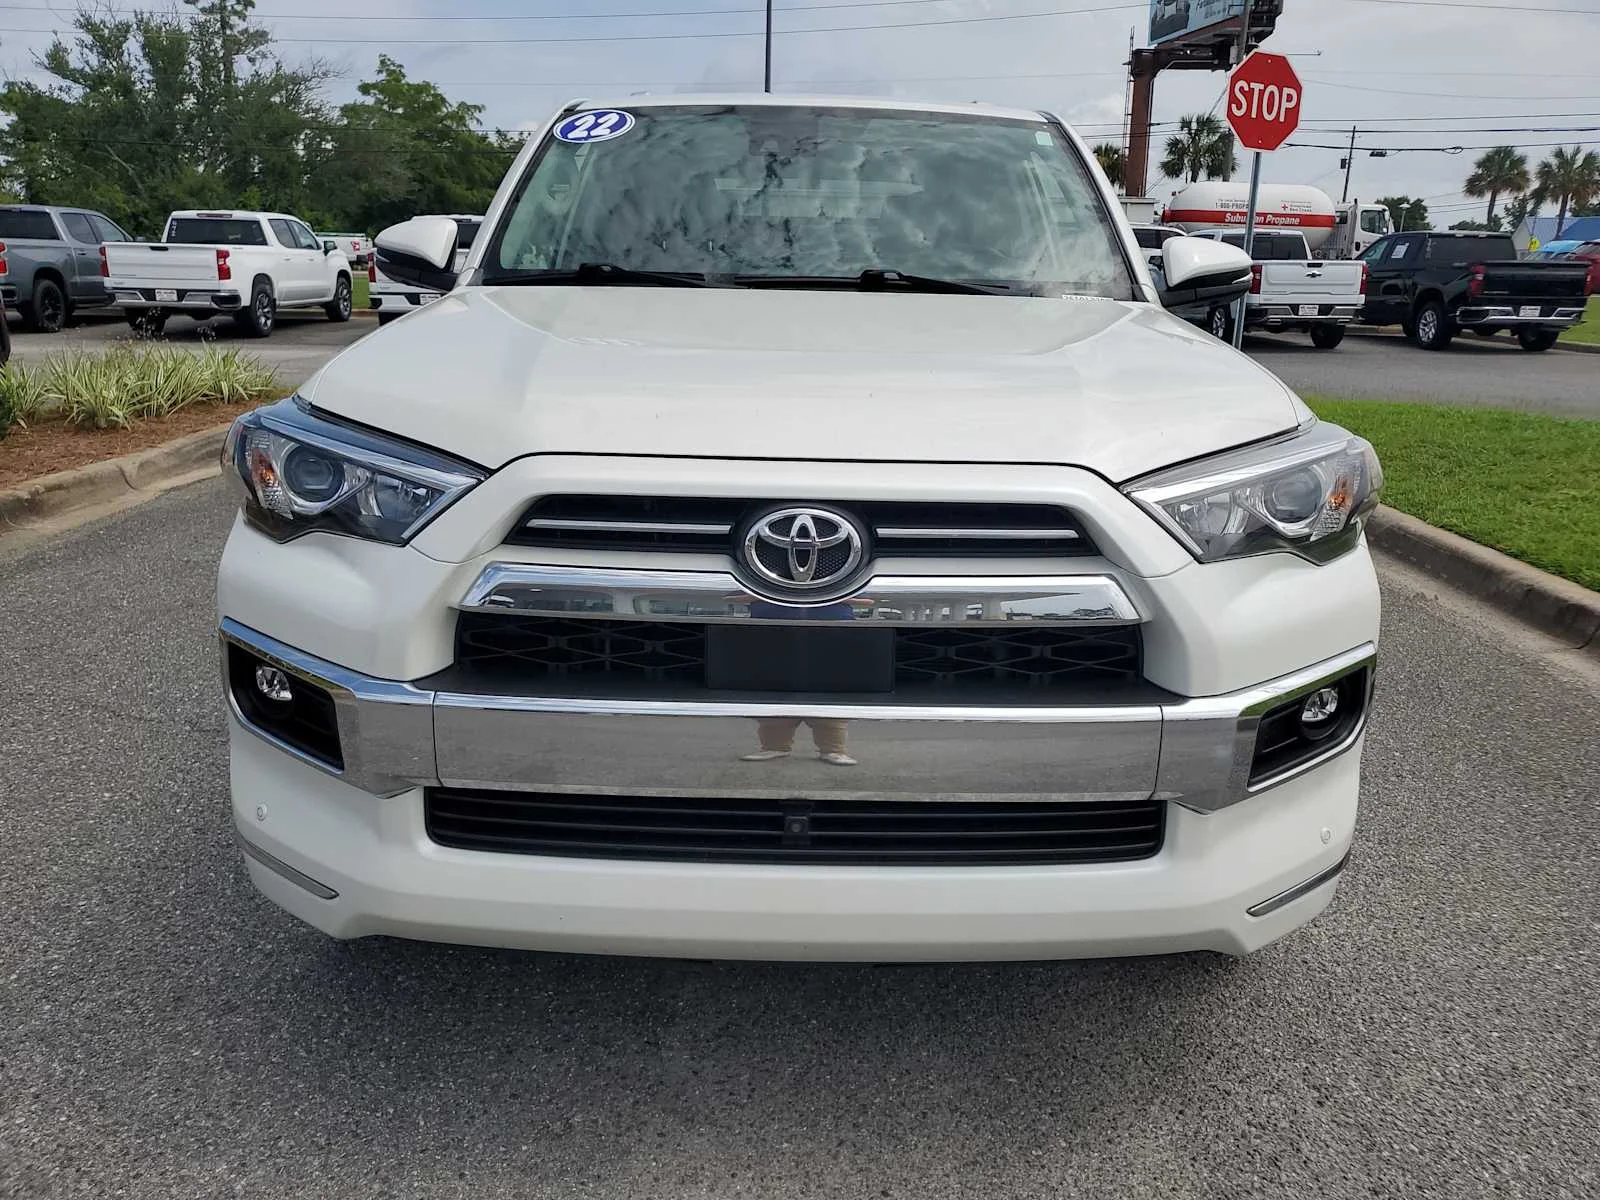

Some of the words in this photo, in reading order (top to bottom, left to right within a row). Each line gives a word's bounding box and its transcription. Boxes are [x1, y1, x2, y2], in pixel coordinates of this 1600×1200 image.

[1231, 80, 1298, 122] STOP
[567, 112, 620, 139] 22
[1224, 212, 1264, 224] Subuan
[1265, 214, 1301, 226] Propane
